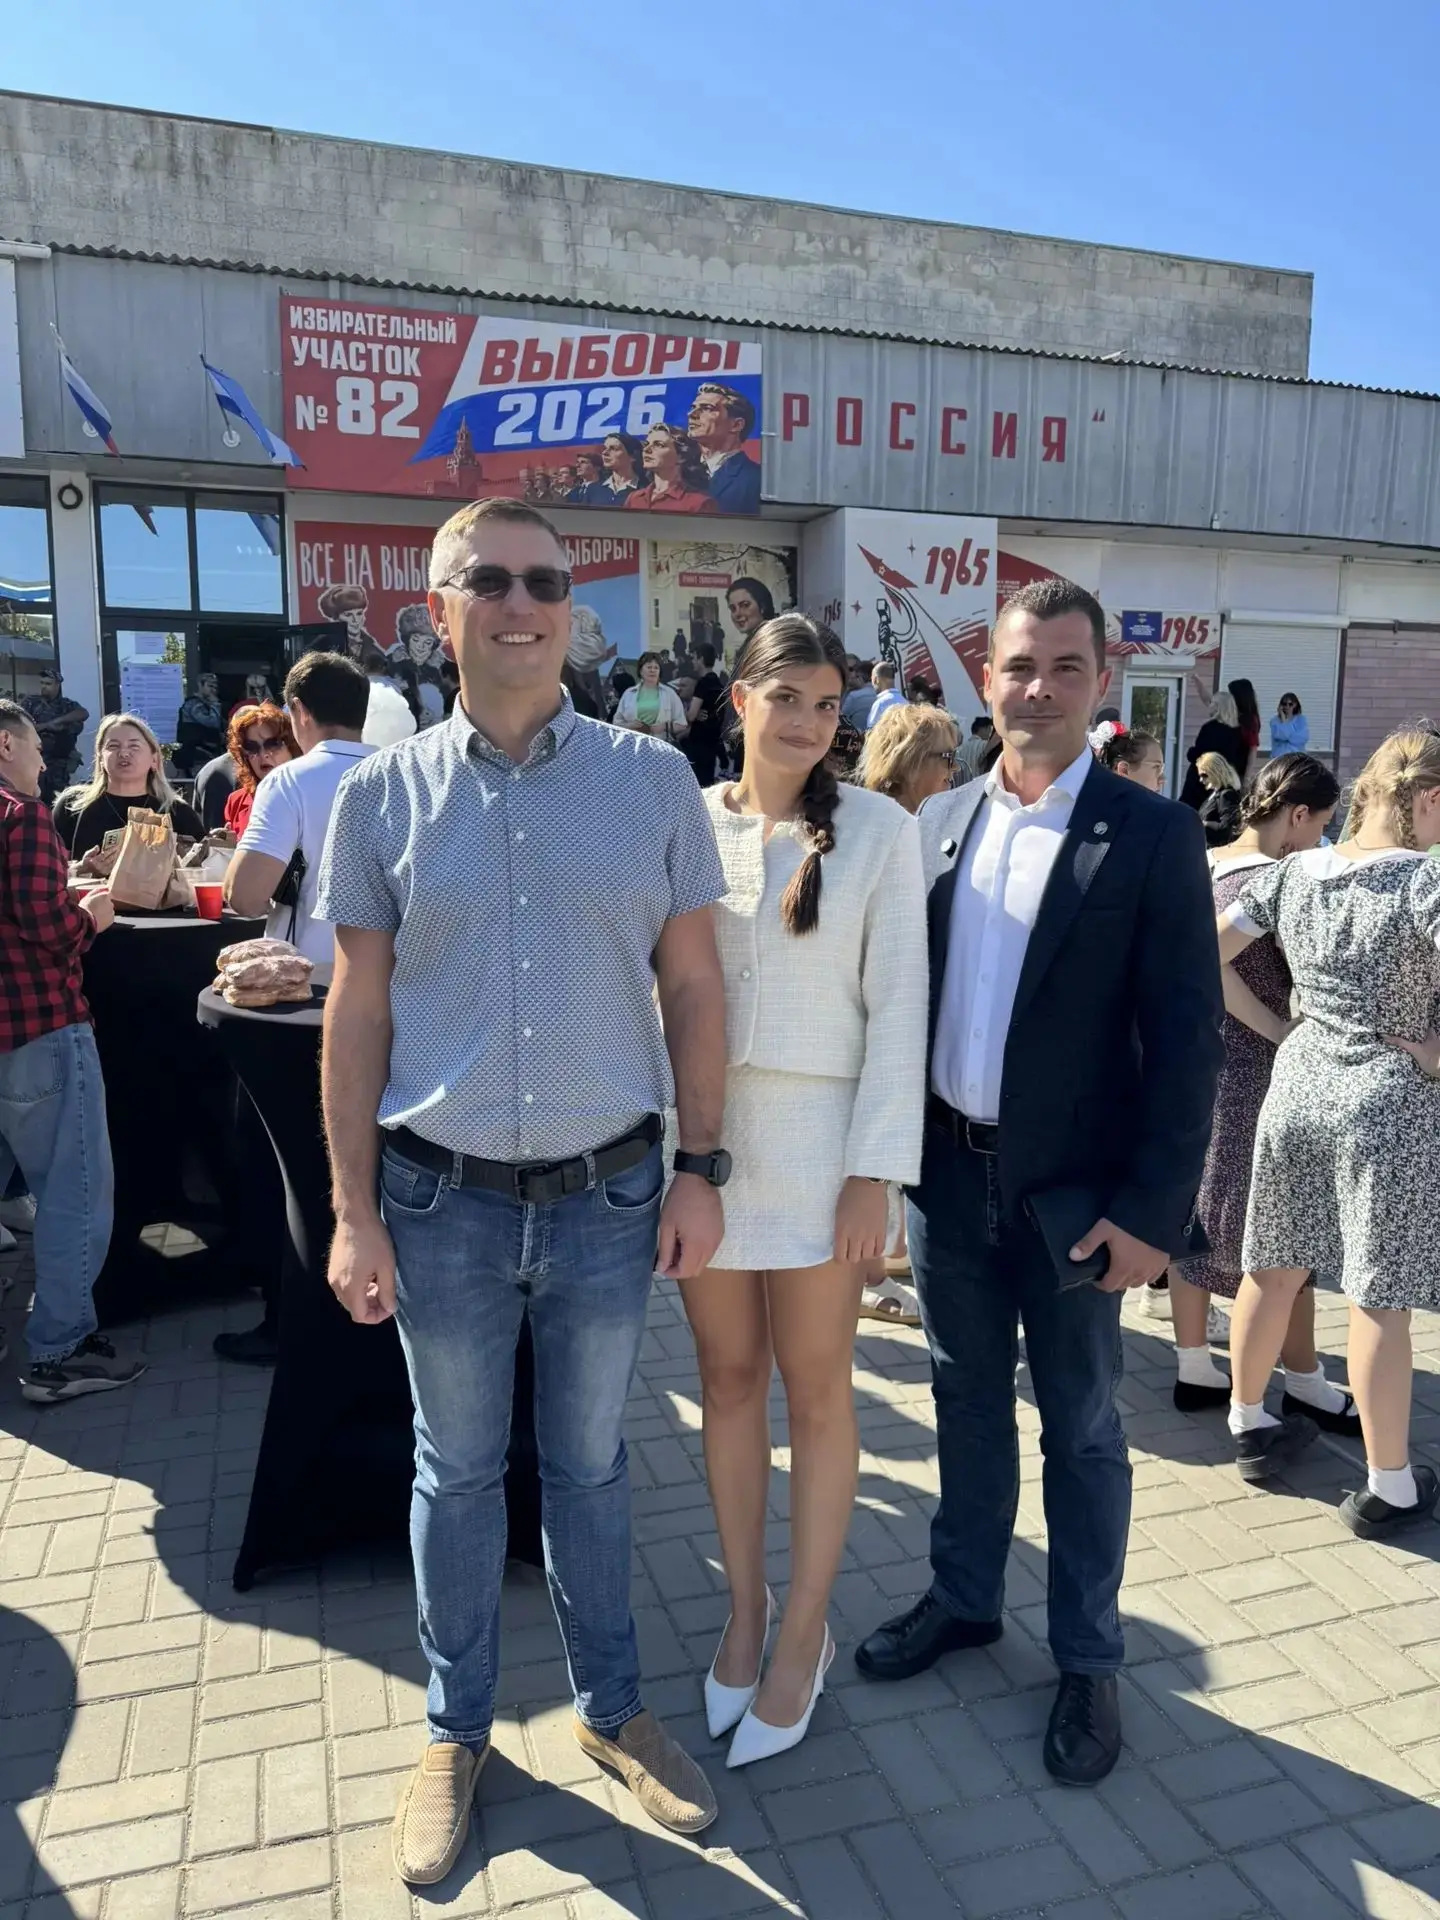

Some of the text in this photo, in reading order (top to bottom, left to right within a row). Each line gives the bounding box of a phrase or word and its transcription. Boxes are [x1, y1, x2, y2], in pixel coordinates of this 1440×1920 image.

[290, 305, 457, 344] ИЗБИРАТЕЛЬНЫЙ
[290, 335, 422, 377] УЧАСТОК
[479, 333, 742, 386] ВЫБОРЫ
[295, 375, 420, 439] № 82
[493, 384, 667, 446] 2026
[300, 542, 432, 592] ВСЕ НА ВЫБО
[565, 538, 634, 568] ЫБОРЫ!
[924, 538, 990, 595] 1965
[1161, 615, 1210, 649] 1965
